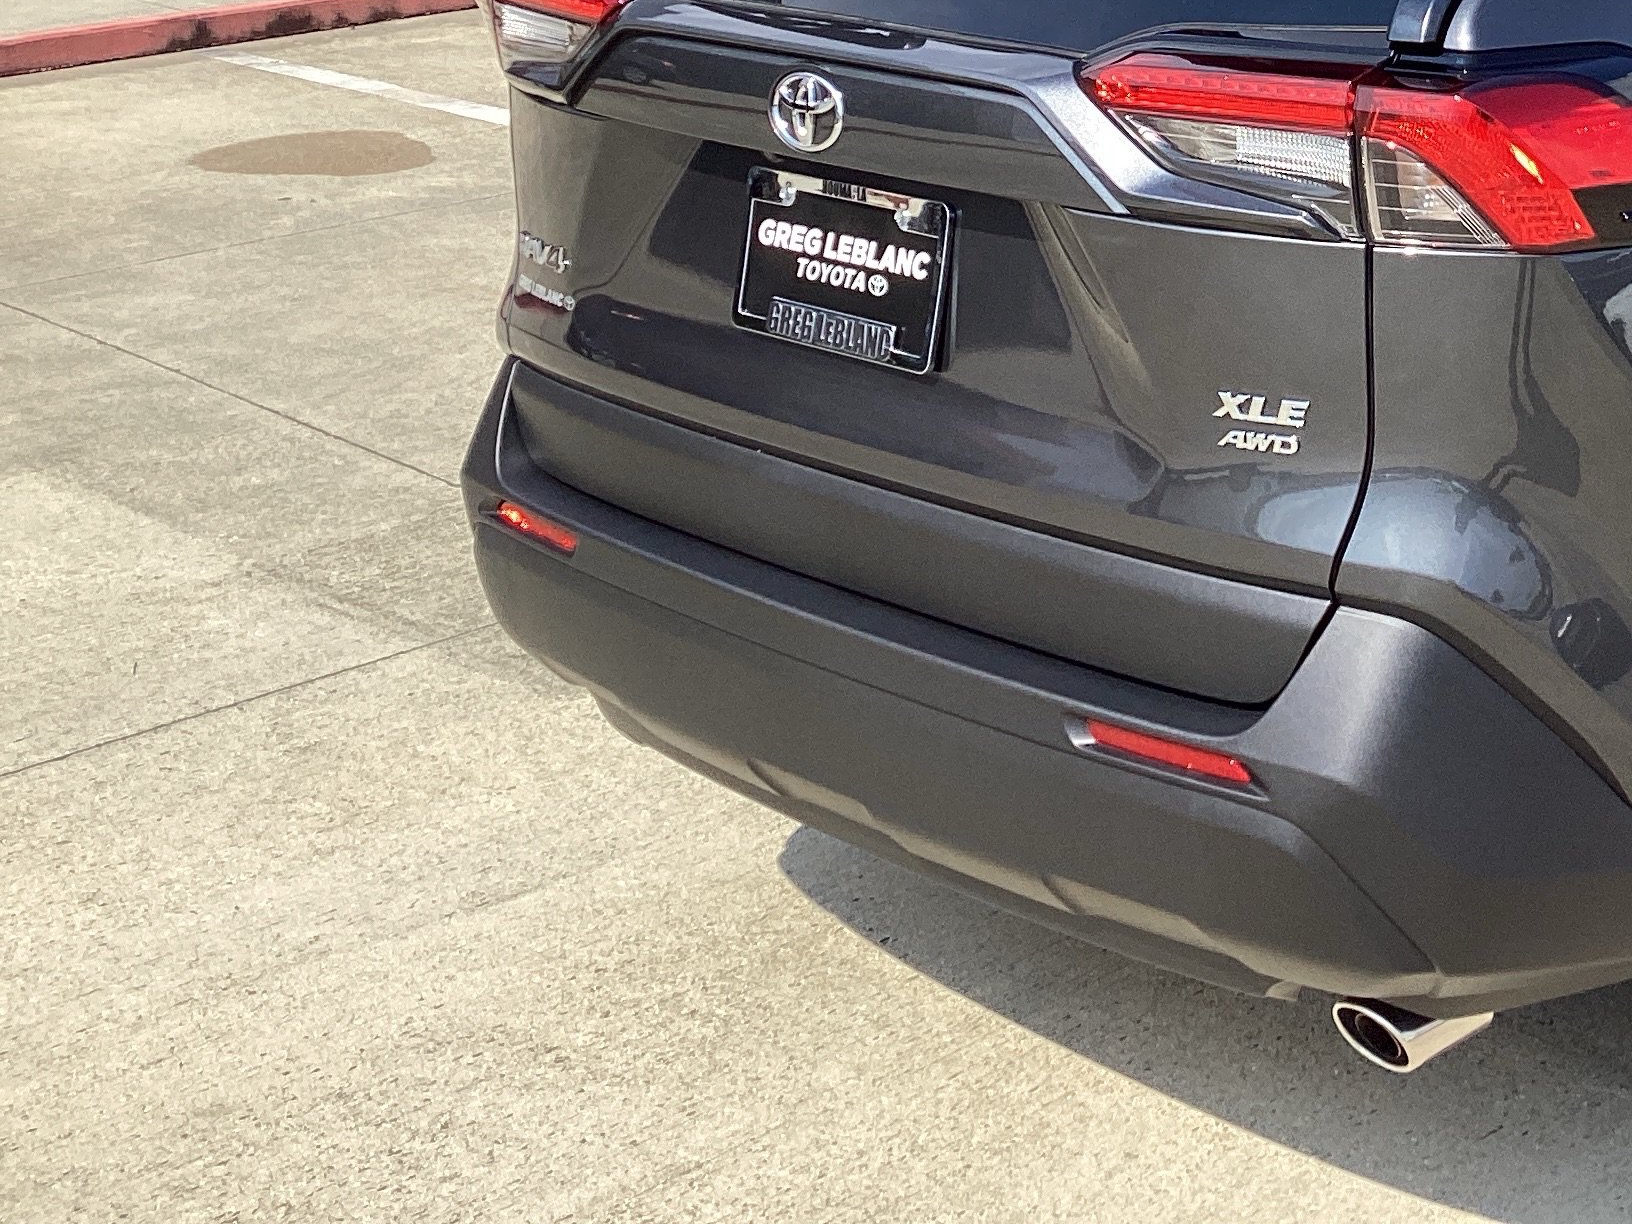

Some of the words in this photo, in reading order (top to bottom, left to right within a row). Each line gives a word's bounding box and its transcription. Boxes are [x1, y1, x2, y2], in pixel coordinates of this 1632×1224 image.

[757, 218, 823, 256] GREG
[822, 231, 932, 280] LEBLANC
[796, 256, 867, 293] TOYOTA
[768, 301, 817, 344] GREG
[814, 311, 893, 362] LEBLANC
[1211, 391, 1310, 428] XLE
[1217, 430, 1299, 455] AWD
